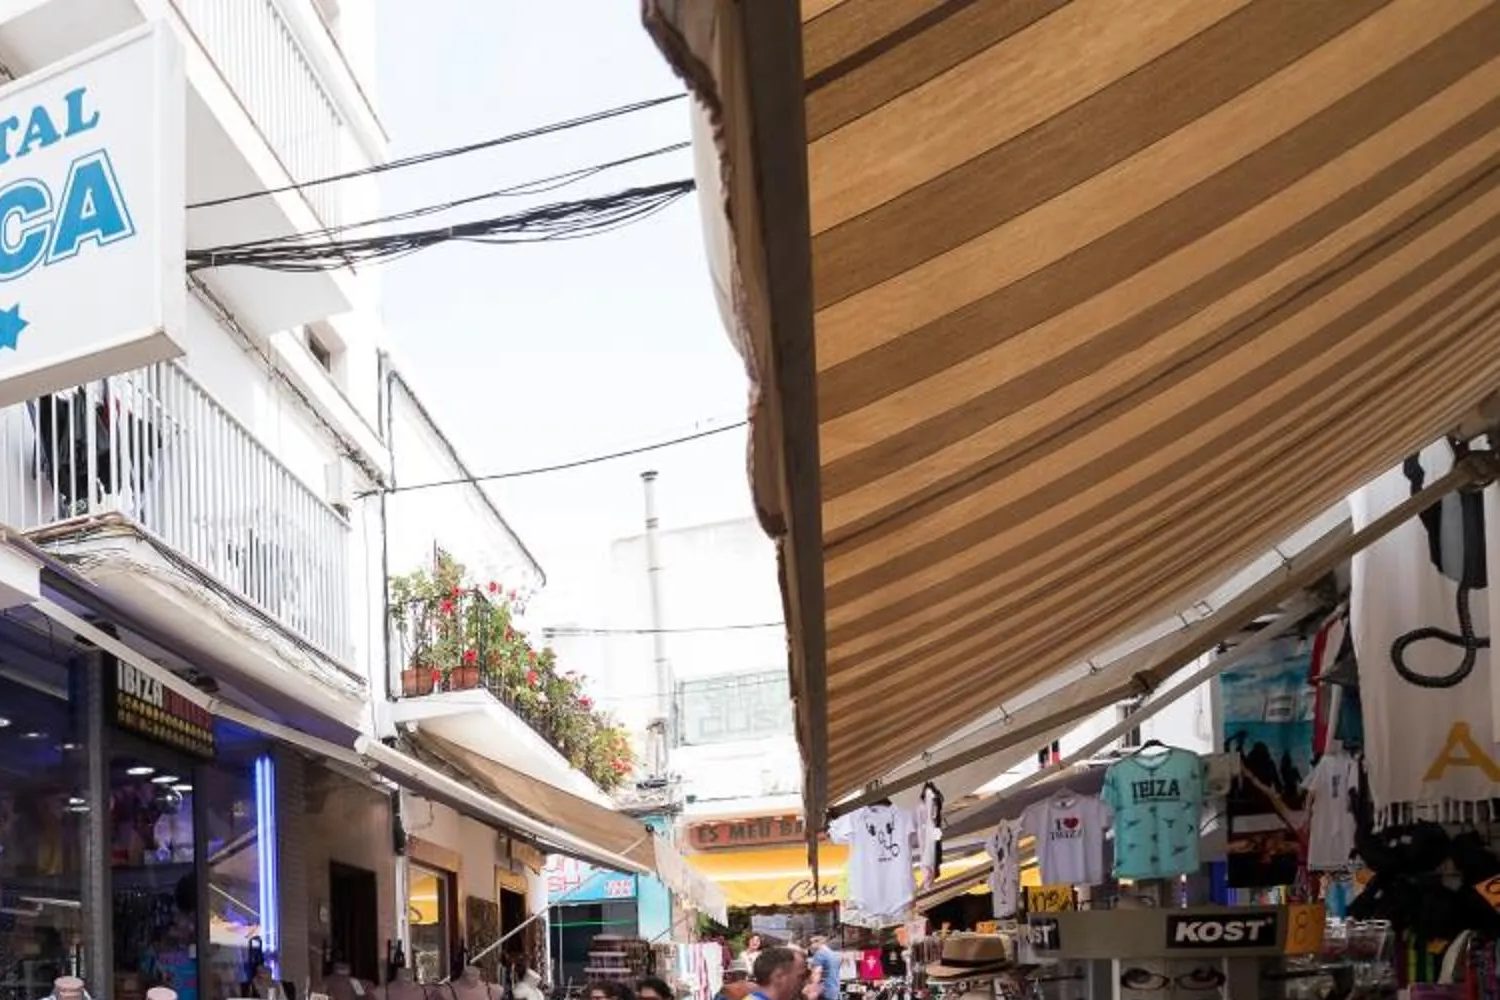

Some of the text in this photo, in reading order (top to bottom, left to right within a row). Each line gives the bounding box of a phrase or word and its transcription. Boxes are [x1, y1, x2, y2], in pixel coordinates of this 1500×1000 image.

[117, 659, 163, 708] IBIZA
[1132, 779, 1181, 800] IBIZA
[1175, 921, 1265, 942] KOST
